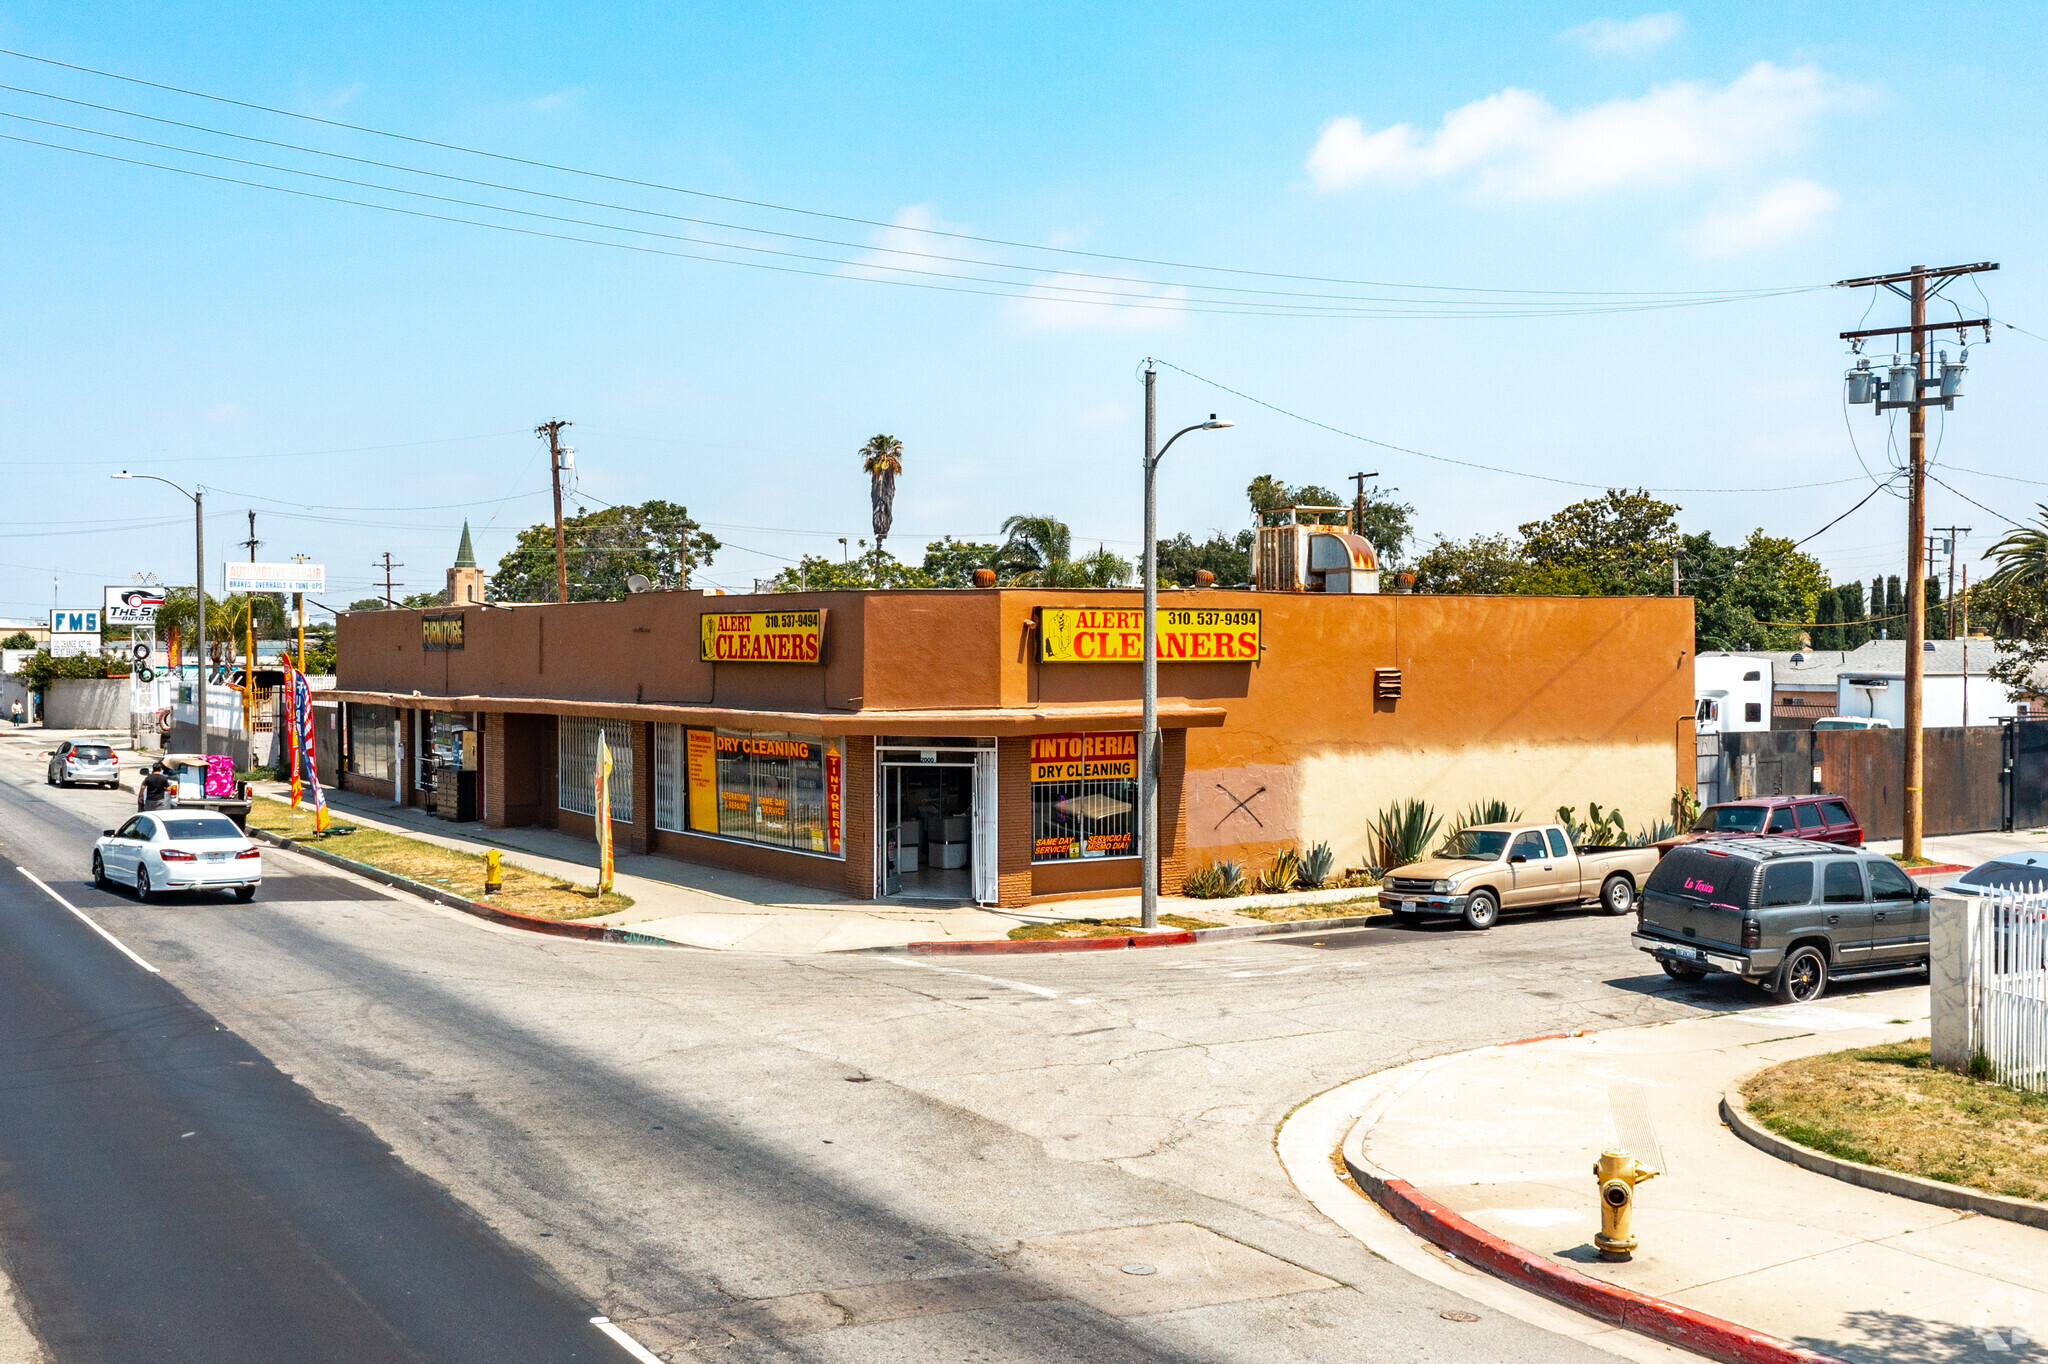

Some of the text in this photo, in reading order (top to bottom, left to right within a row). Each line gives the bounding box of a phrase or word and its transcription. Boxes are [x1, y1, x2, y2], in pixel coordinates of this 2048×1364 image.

[229, 566, 321, 579] AUTOMOTIVE REPAIR
[255, 581, 287, 589] OVERHAULS
[295, 582, 322, 590] TUNE-UPS
[110, 606, 139, 616] THE
[55, 613, 96, 631] FMS
[718, 614, 818, 632] ALERT 310. 537-9494
[1075, 612, 1256, 629] ALERT 310. 537-9494
[422, 620, 463, 643] FURNITURE
[715, 633, 818, 661] CLEANERS
[716, 736, 809, 759] DRY CLEANING
[1031, 736, 1135, 758] TINTORERIA
[1038, 762, 1130, 779] DRY CLEANING
[721, 791, 751, 804] ALTERATIONS
[758, 796, 788, 808] SAME DAY!
[829, 757, 841, 846] TINTORERIA
[729, 801, 748, 812] REPAIRS
[761, 805, 786, 817] SERVICE
[1035, 836, 1075, 847] SAME DAY
[1087, 833, 1132, 843] SERVICIO EL
[1034, 845, 1070, 855] SERVICE!
[1086, 842, 1112, 852] MISMO
[1111, 842, 1128, 850] DIA!
[1684, 877, 1694, 889] La
